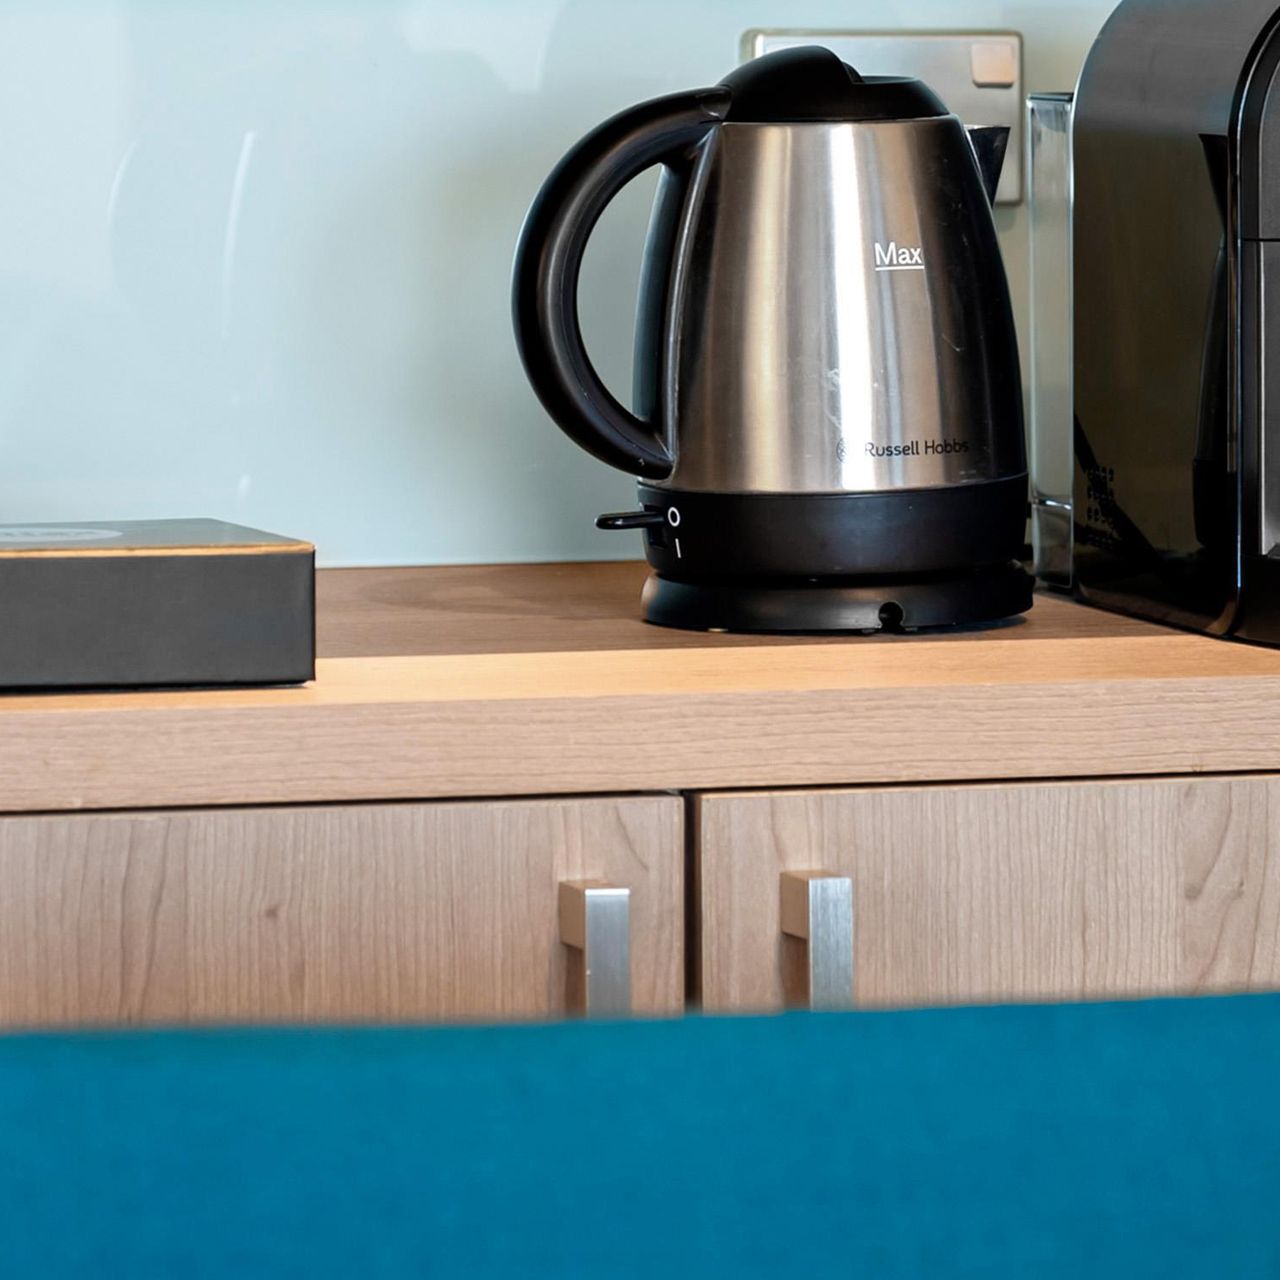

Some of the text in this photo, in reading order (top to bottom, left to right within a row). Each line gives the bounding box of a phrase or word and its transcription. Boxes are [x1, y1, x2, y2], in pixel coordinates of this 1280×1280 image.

[874, 241, 922, 265] Max
[865, 438, 969, 457] Russell Hobbs
